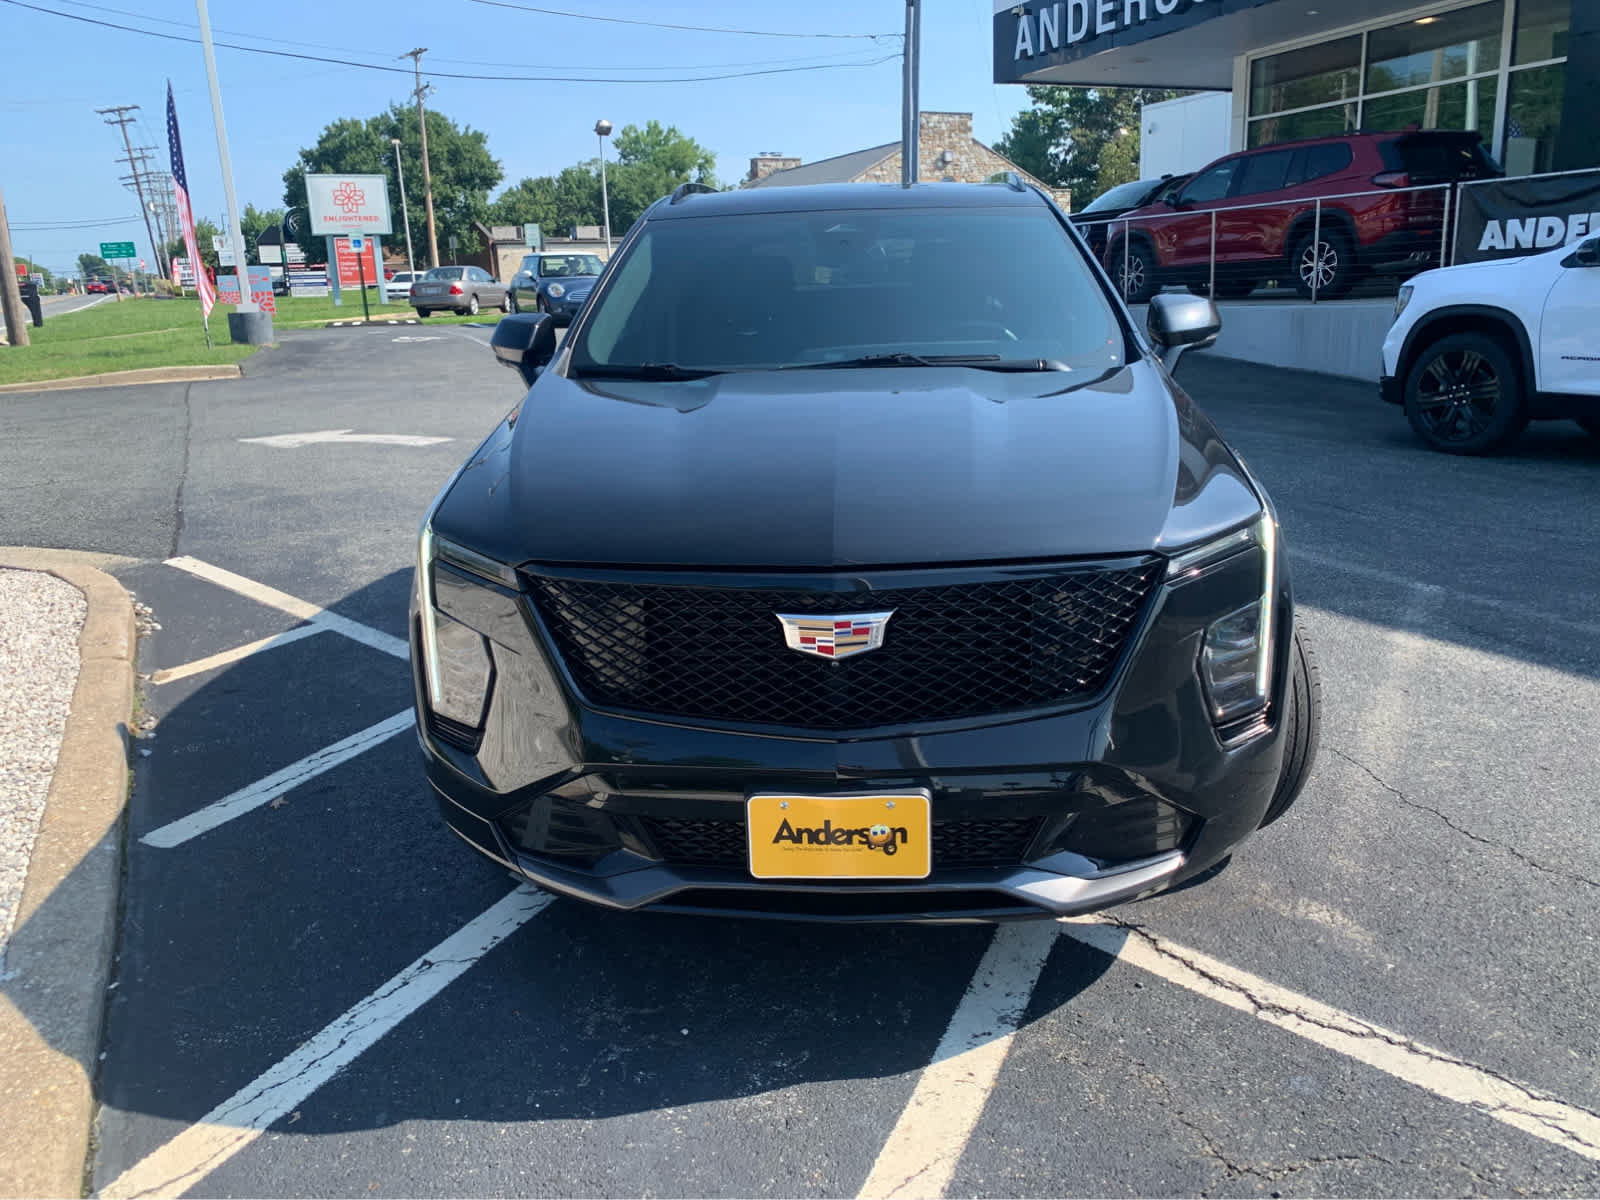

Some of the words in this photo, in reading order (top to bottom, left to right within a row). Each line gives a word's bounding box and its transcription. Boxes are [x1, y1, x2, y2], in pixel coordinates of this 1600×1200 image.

[1014, 0, 1206, 60] ANDER
[323, 215, 380, 223] ENLIGHTENED
[772, 817, 908, 846] Anderson
